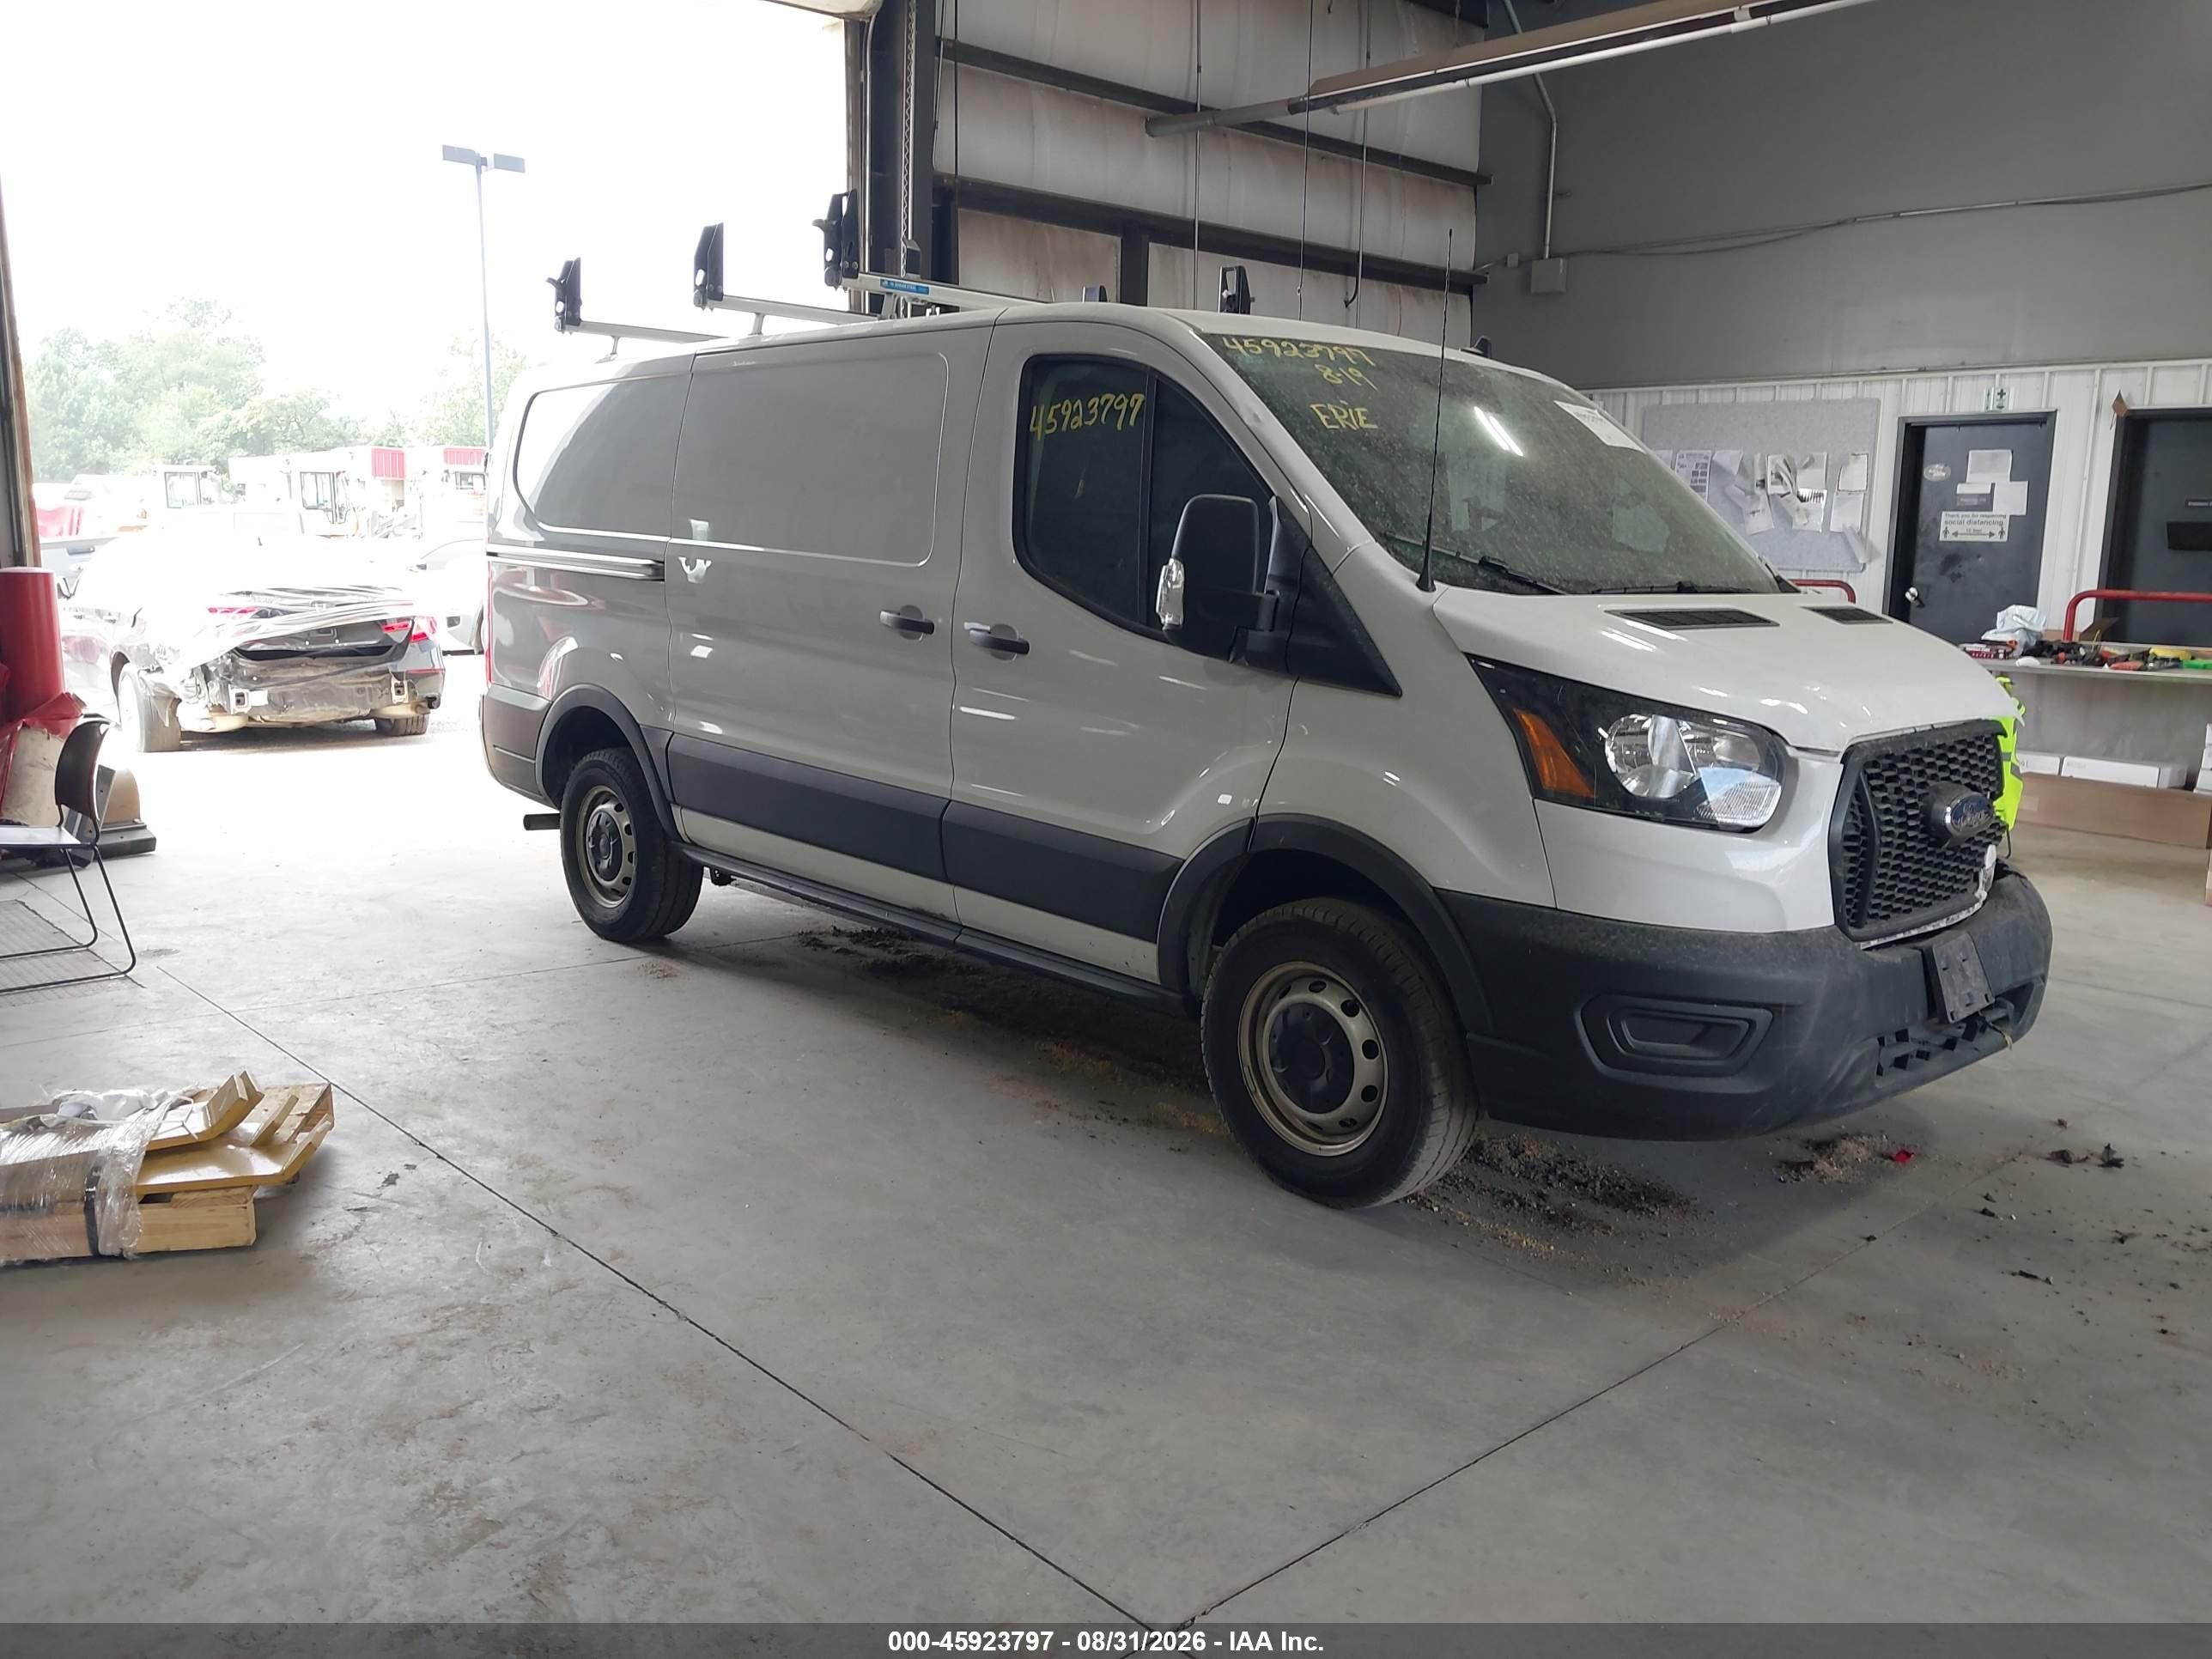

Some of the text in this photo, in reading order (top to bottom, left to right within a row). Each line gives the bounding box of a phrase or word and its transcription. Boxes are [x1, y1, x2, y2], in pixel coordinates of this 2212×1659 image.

[1222, 337, 1376, 367] 45923797
[1030, 392, 1146, 441] 45923797
[1310, 401, 1378, 430] ERIE
